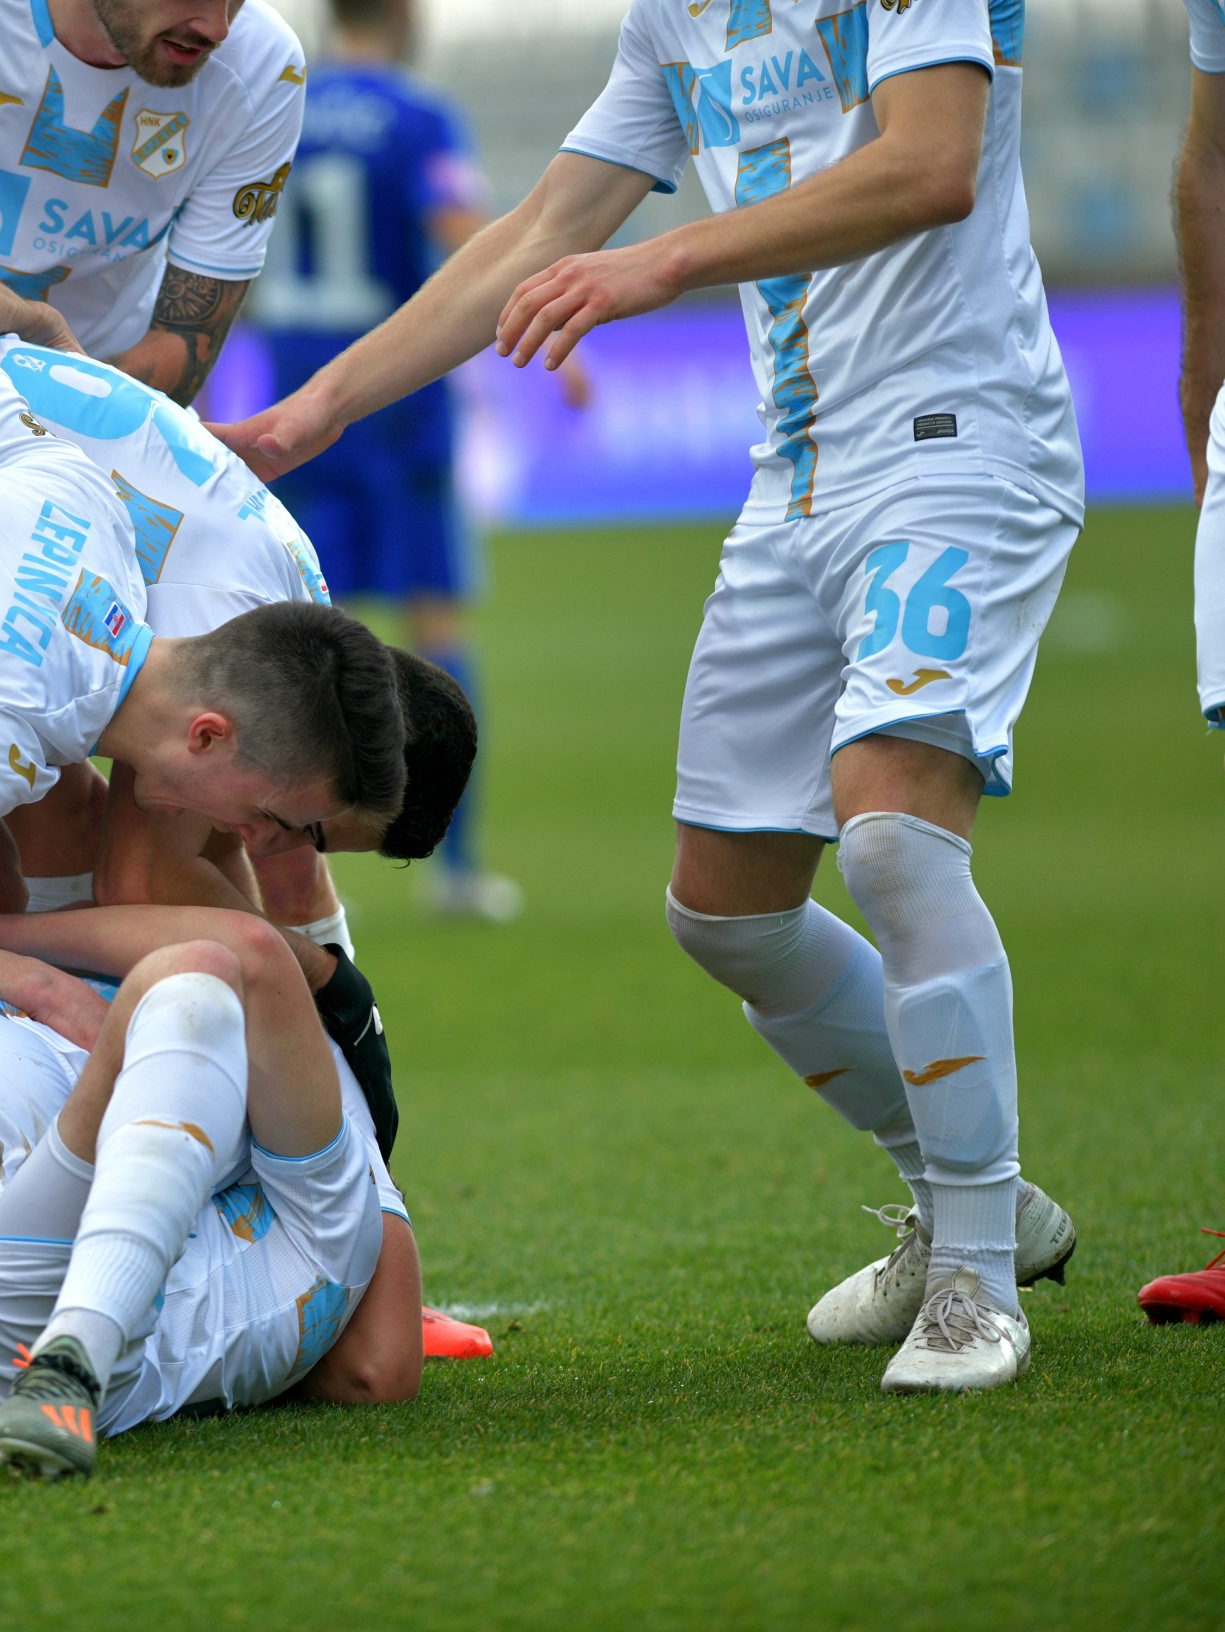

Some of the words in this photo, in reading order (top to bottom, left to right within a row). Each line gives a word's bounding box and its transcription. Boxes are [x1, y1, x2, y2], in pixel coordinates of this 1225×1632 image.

[741, 47, 826, 105] SAVA
[744, 86, 834, 124] OSIGURANJE
[38, 198, 150, 251] SAVA
[856, 541, 972, 662] 36
